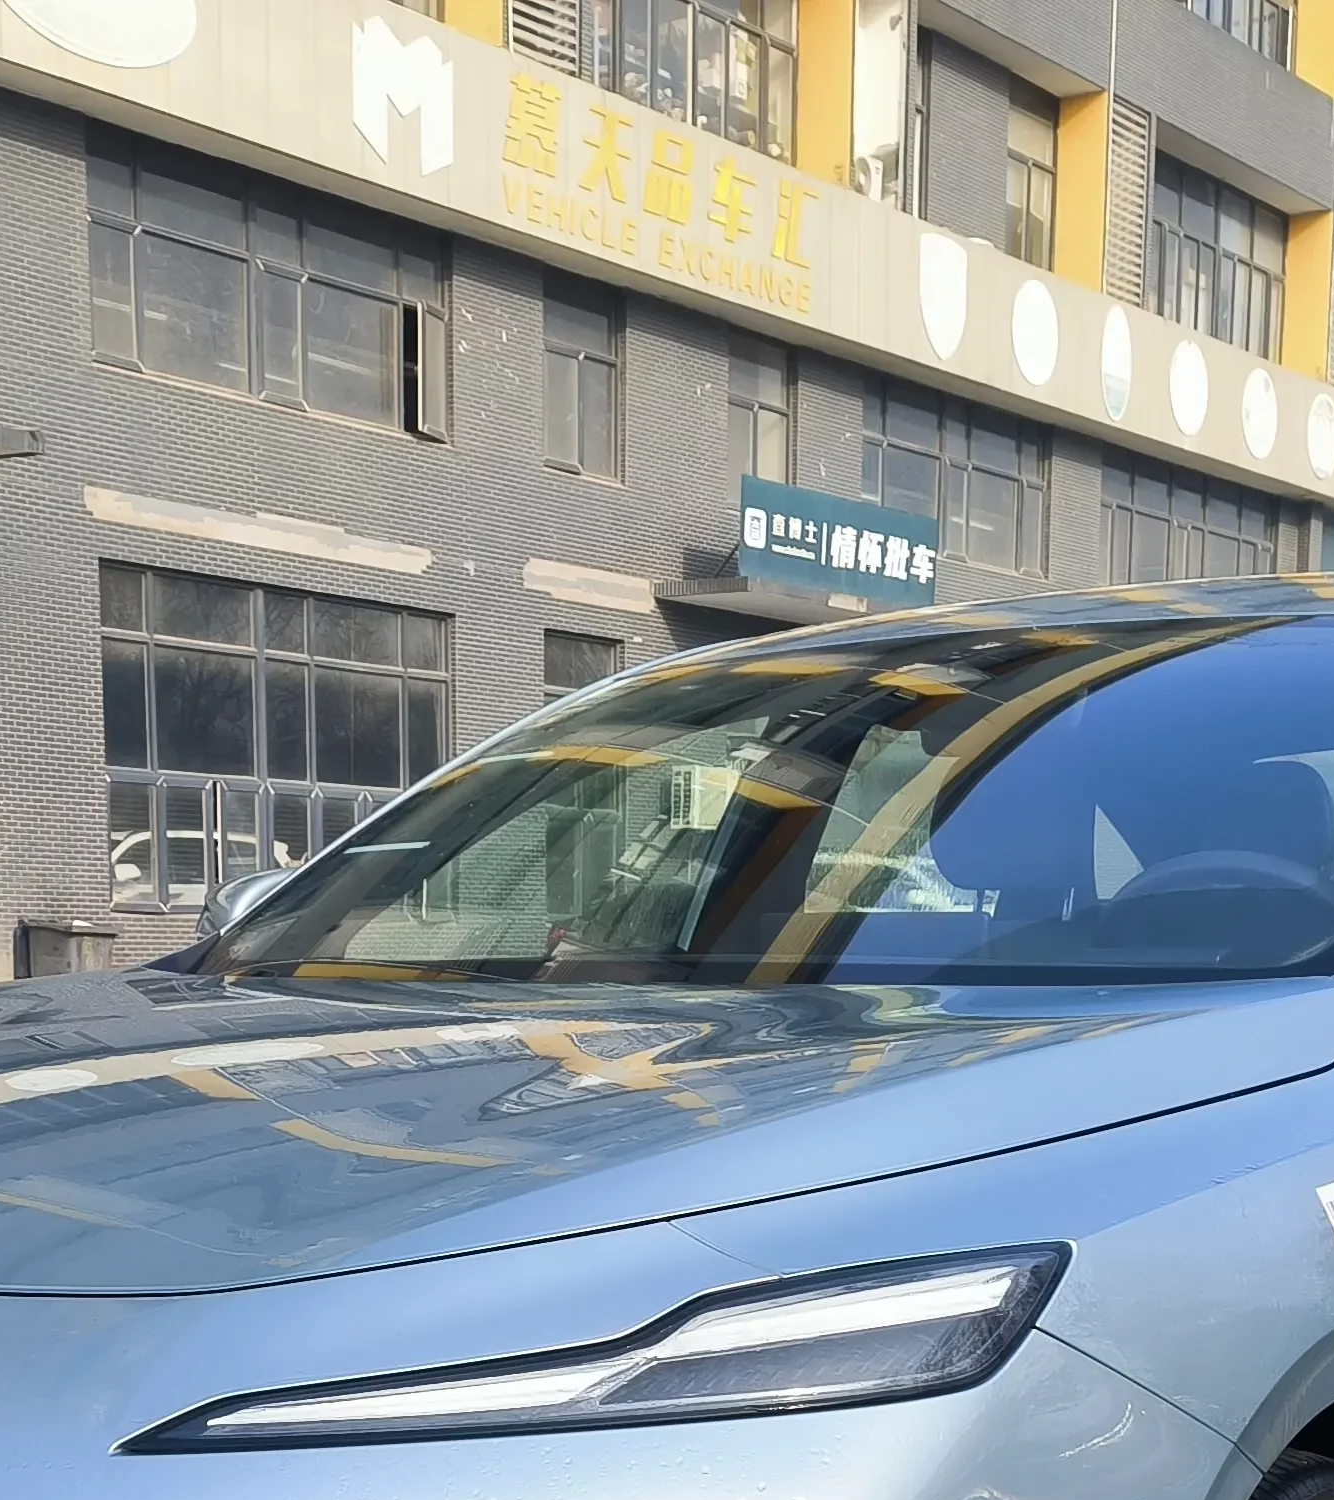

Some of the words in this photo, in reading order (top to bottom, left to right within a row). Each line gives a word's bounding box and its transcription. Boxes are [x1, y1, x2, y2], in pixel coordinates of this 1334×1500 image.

[501, 172, 638, 256] VEHICLE
[659, 227, 812, 314] EXCHANGE
[830, 524, 936, 584] 情怀批车
